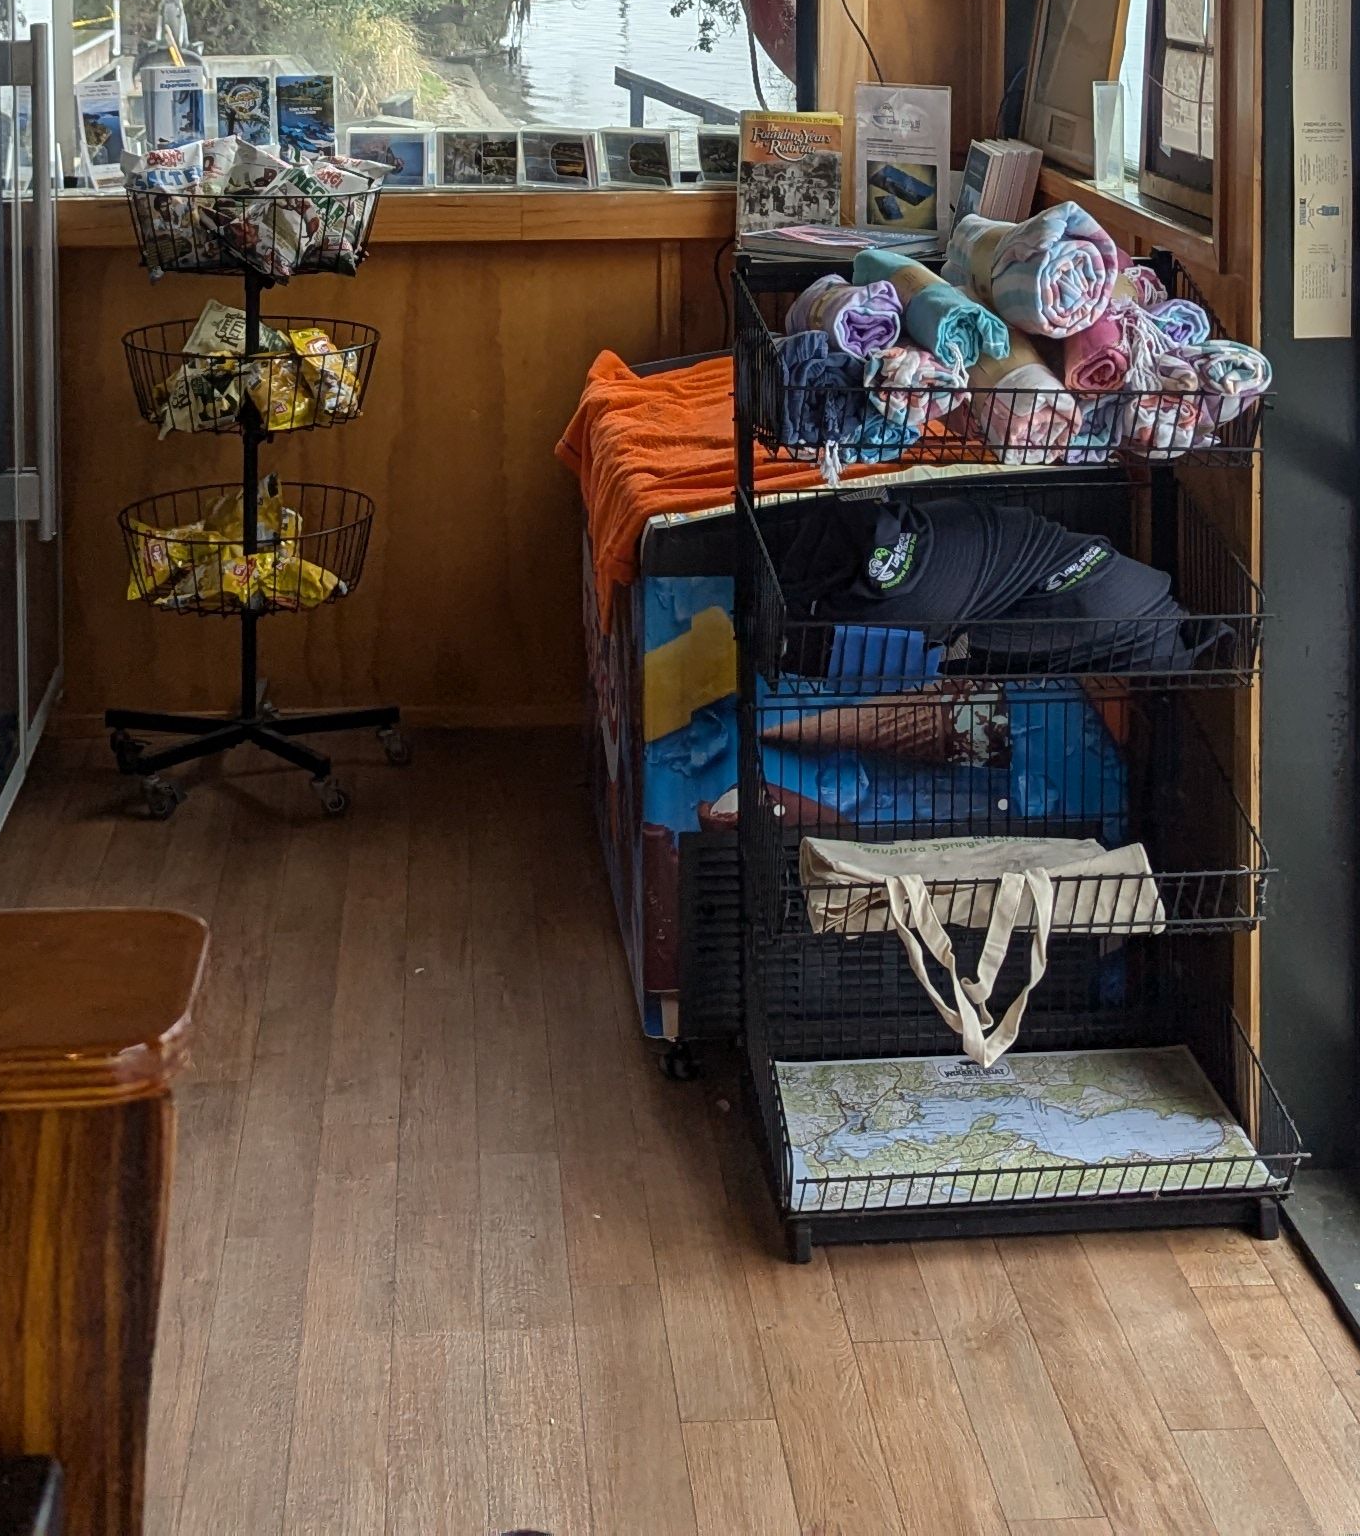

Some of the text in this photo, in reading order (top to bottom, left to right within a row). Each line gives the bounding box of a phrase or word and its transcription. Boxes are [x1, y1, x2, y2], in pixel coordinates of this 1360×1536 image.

[752, 126, 832, 145] Founding Years
[768, 139, 817, 161] Rotorua
[933, 841, 980, 853] Springs
